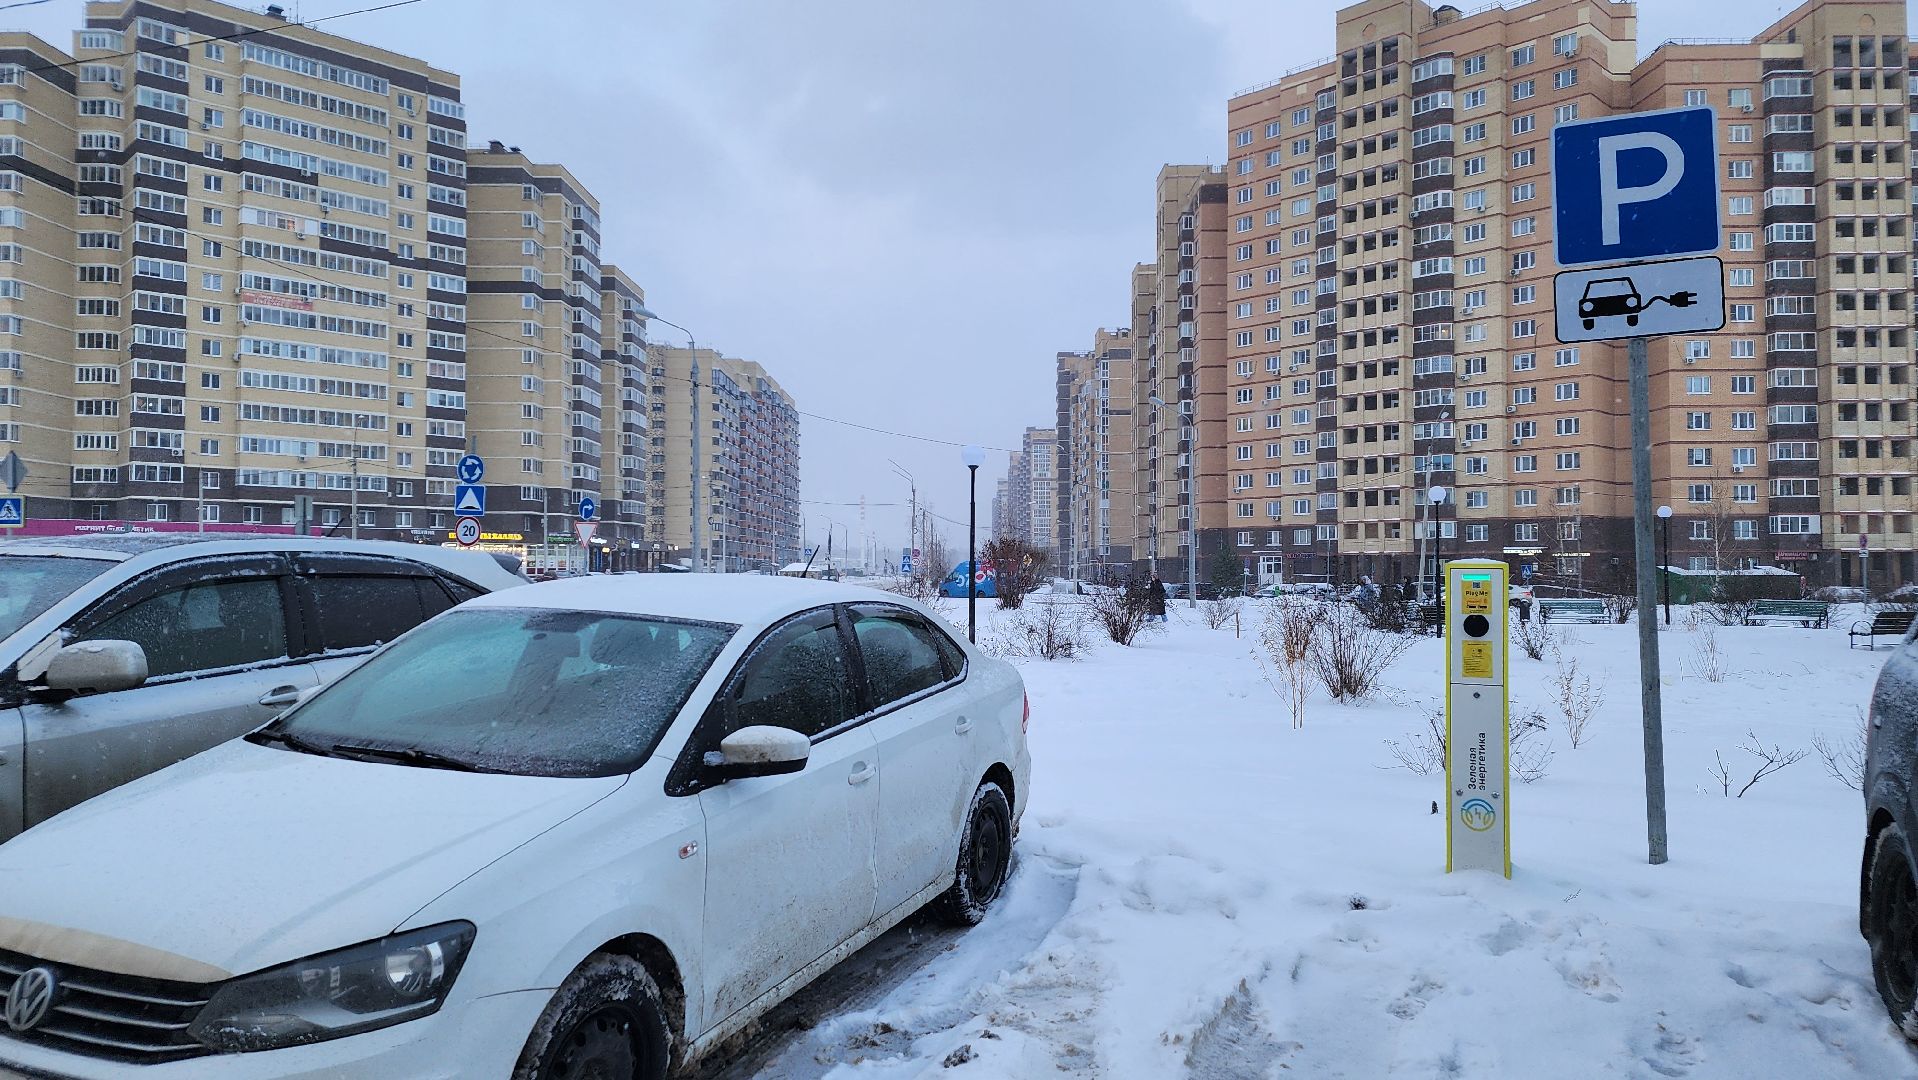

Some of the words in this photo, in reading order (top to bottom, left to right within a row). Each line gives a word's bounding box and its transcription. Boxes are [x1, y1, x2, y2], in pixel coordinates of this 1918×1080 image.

[1598, 131, 1685, 246] P
[462, 525, 476, 537] 20
[1478, 732, 1488, 791] энергетика
